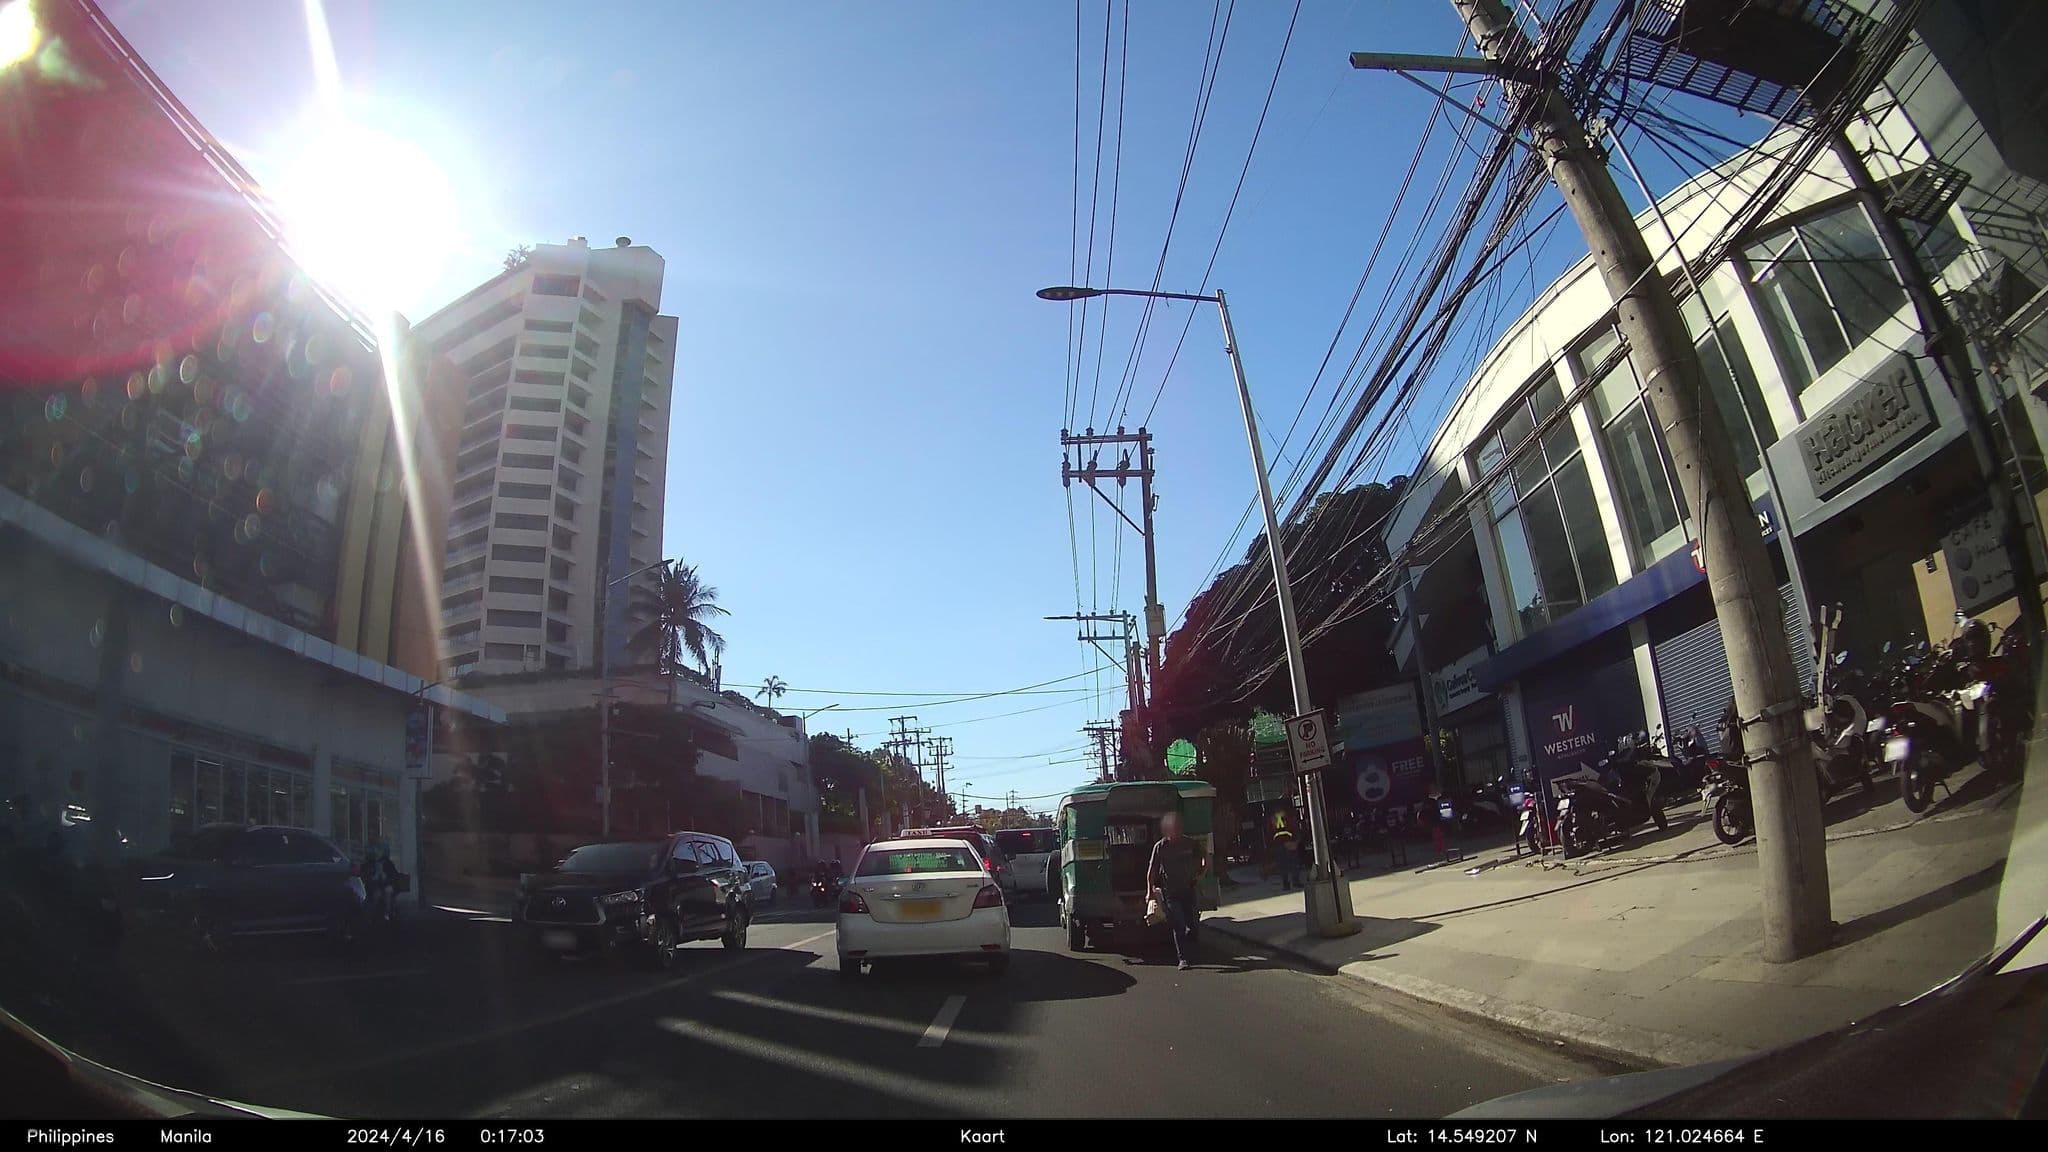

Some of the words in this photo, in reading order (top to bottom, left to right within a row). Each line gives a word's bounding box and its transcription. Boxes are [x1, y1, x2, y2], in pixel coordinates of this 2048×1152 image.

[1305, 740, 1317, 748] NO
[1543, 732, 1596, 756] WESTERN
[1391, 755, 1425, 774] FREE
